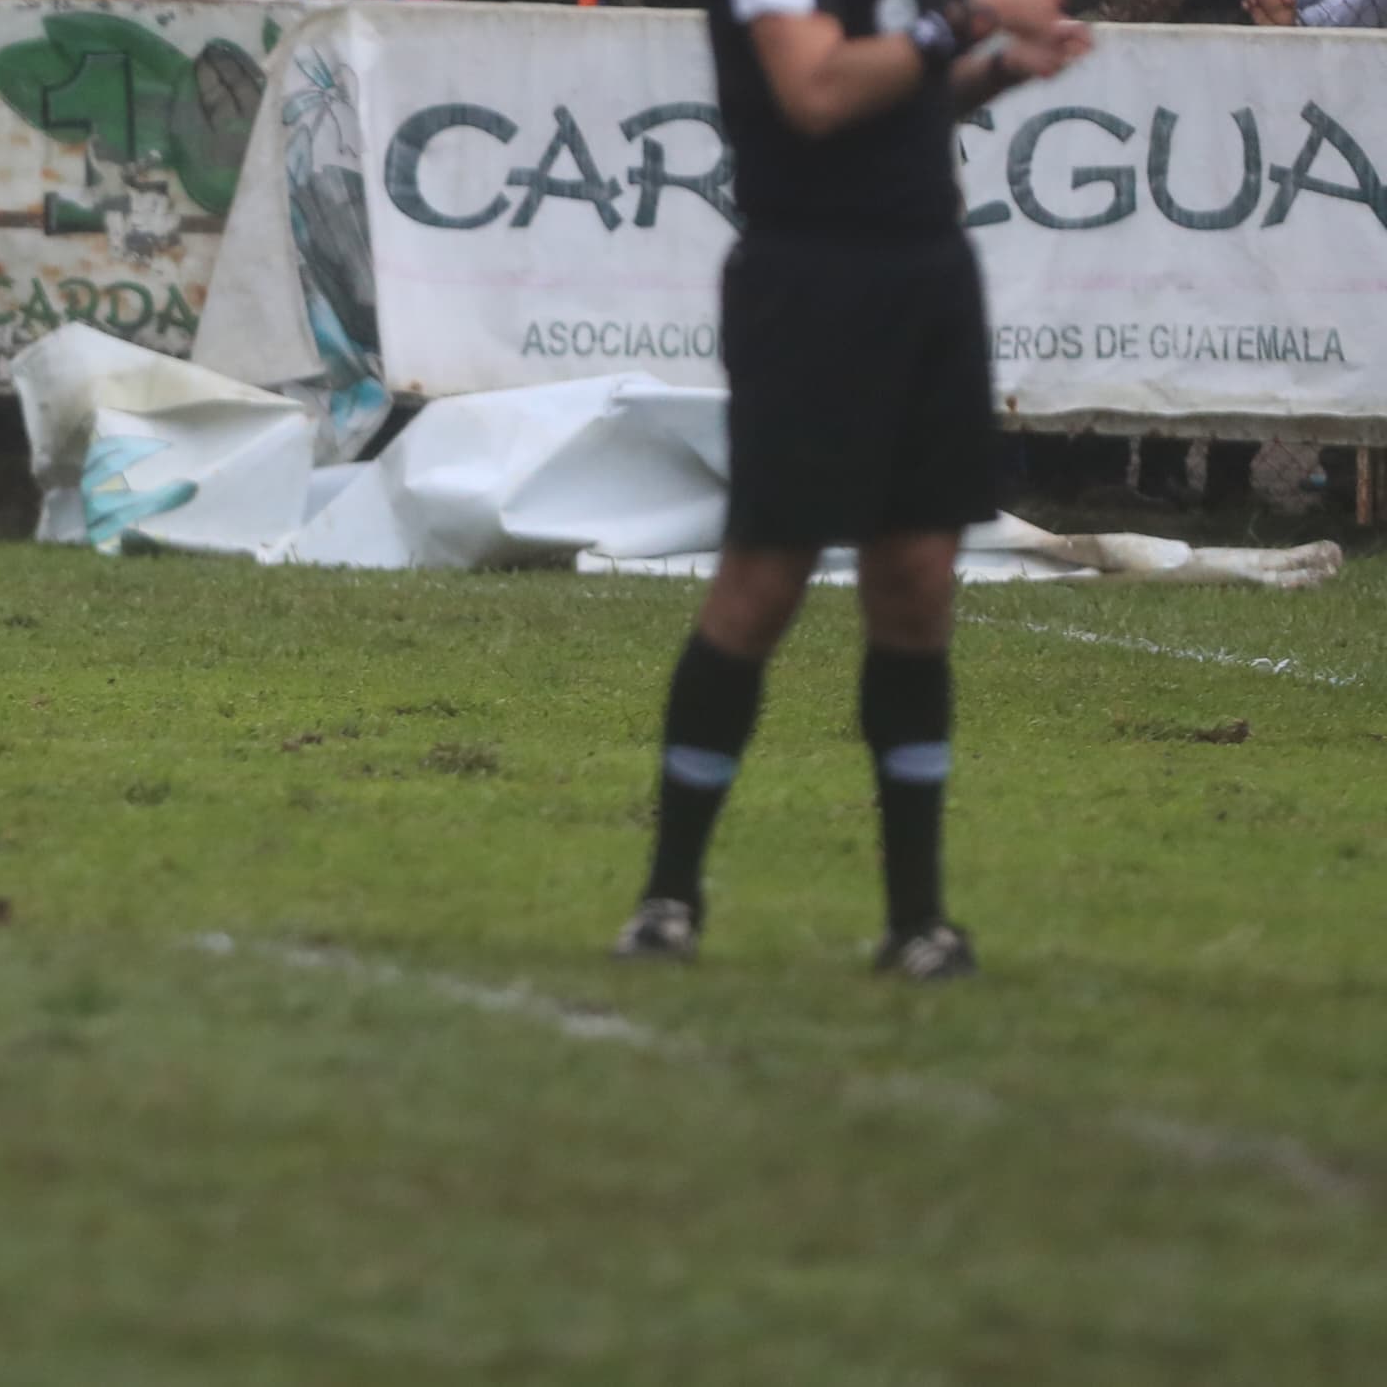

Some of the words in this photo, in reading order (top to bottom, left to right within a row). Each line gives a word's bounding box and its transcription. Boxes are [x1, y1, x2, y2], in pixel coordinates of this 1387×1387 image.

[522, 320, 723, 360] ASOCIACIO
[1095, 323, 1140, 361] DE
[1149, 323, 1348, 365] GUATEMALA
